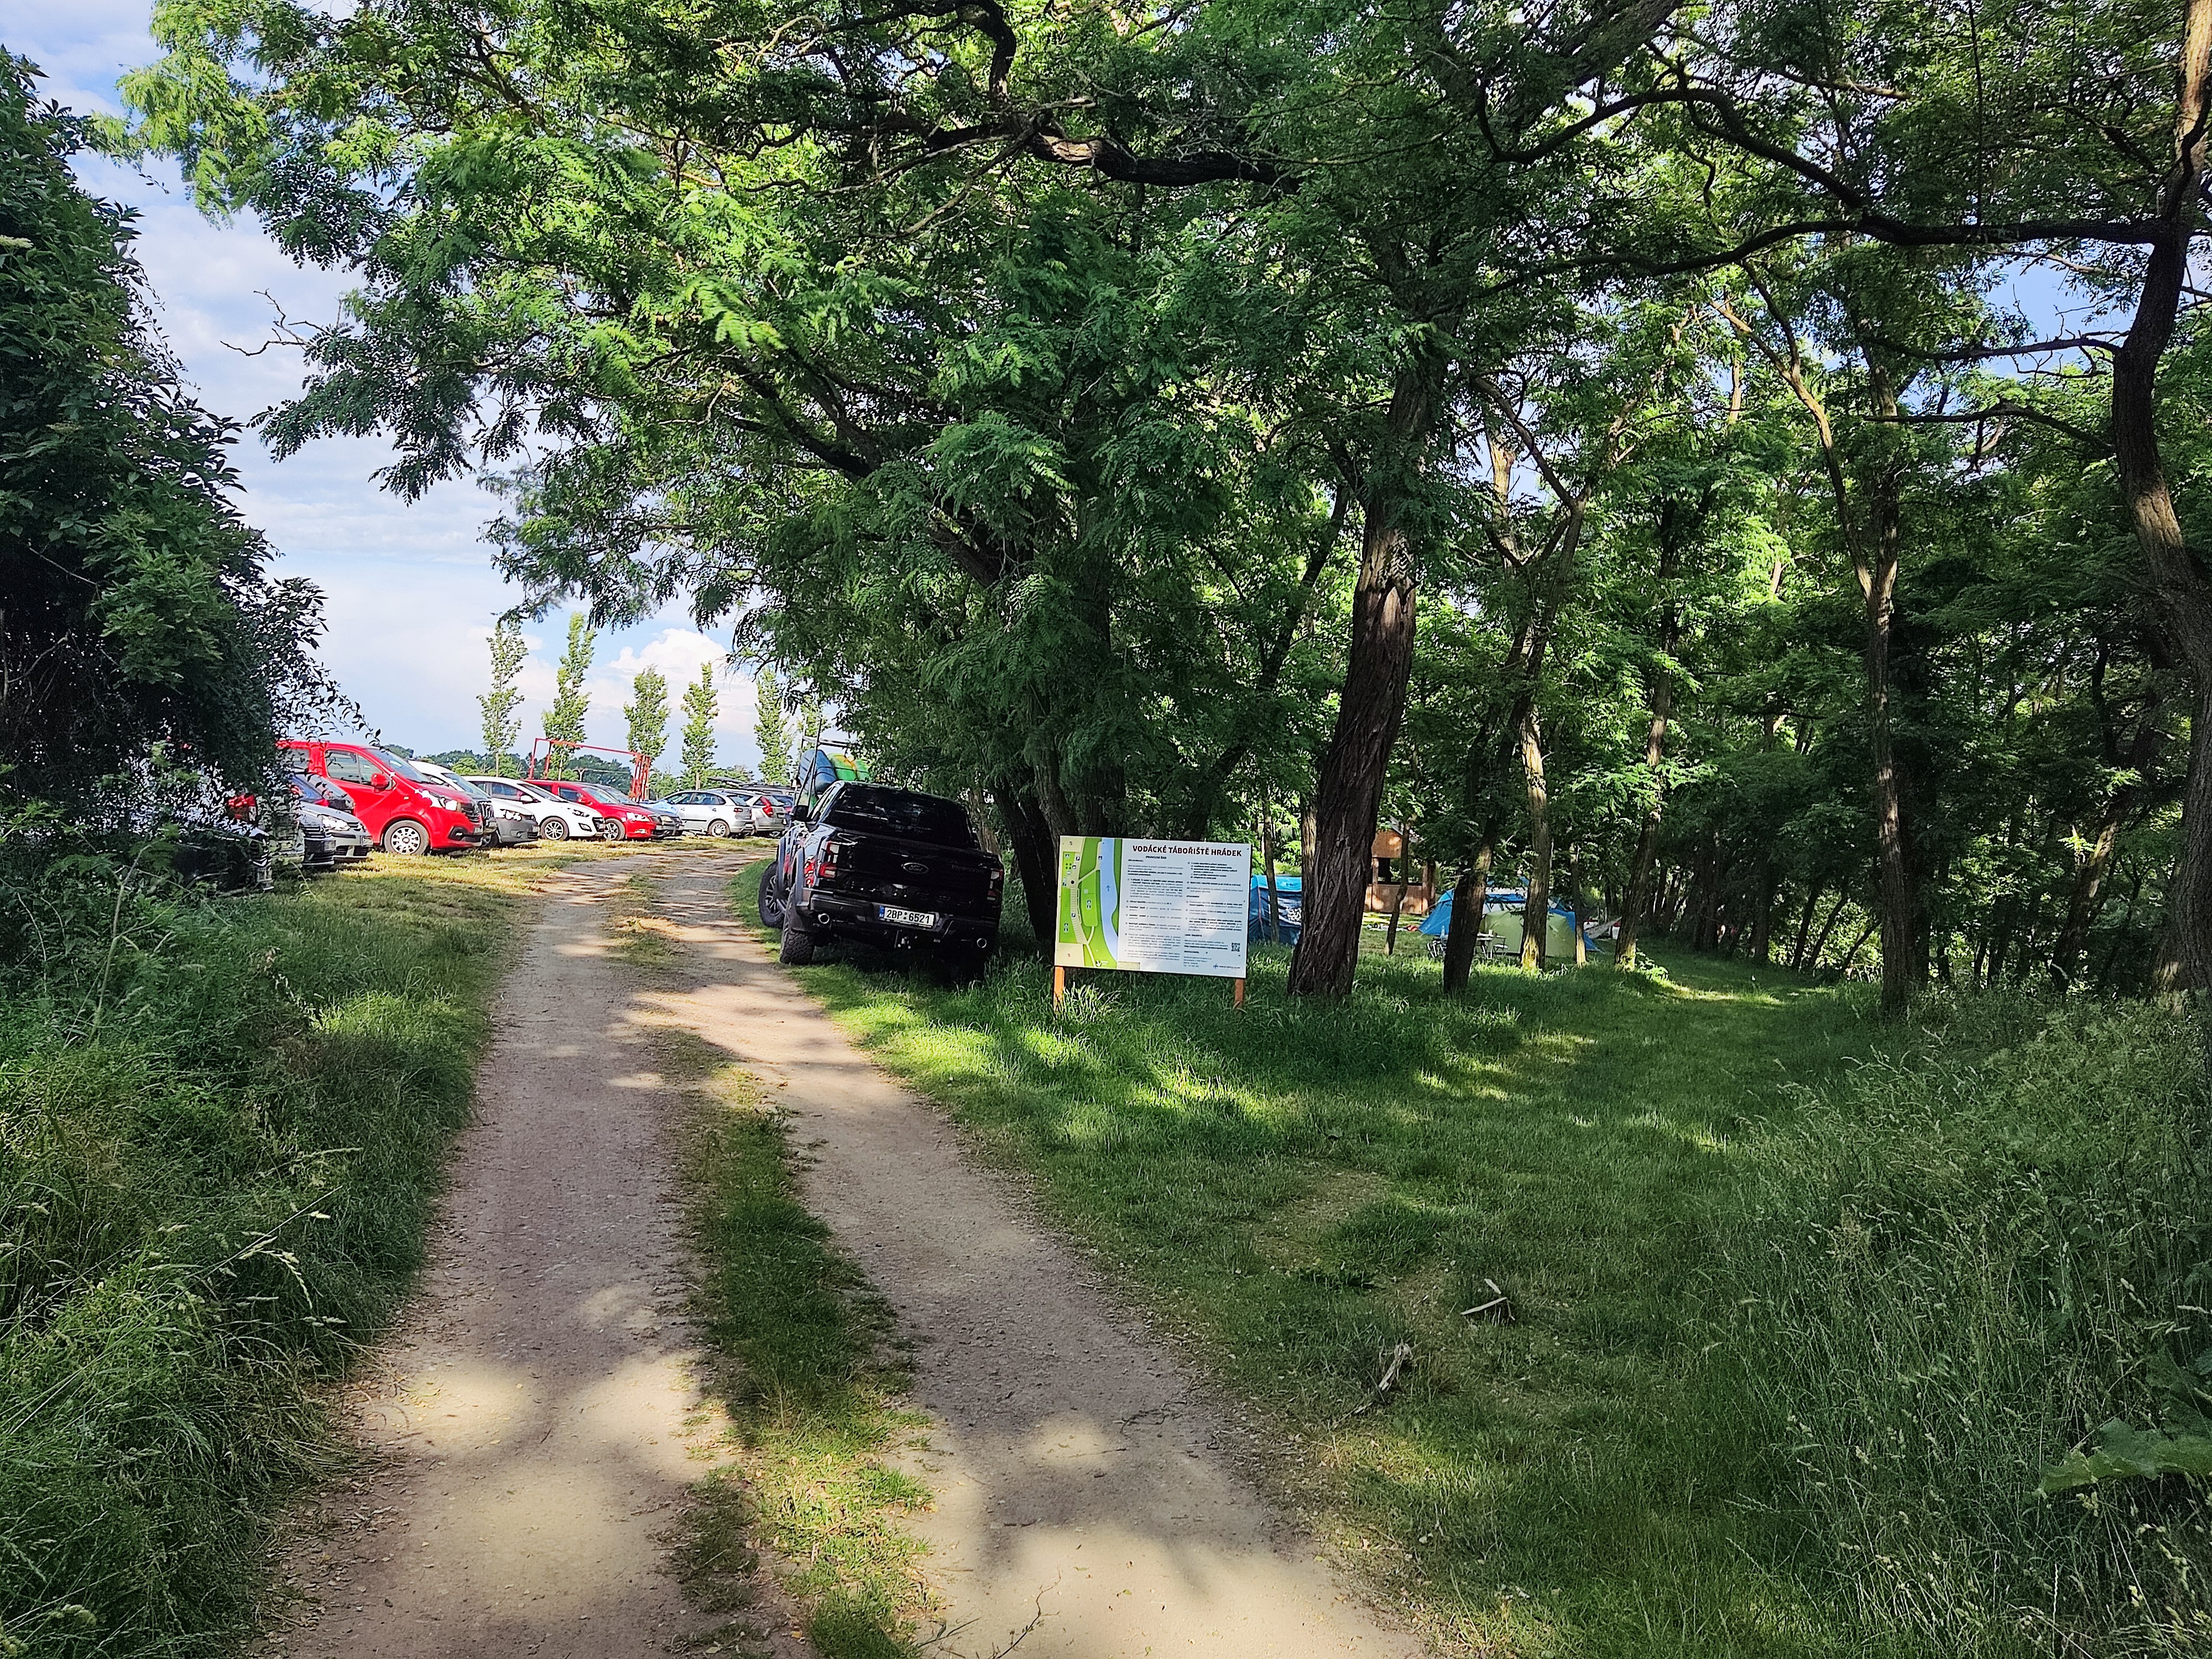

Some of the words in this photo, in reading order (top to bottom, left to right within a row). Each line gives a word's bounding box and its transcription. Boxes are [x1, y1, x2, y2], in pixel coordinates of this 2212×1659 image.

[1133, 844, 1166, 853] VODÁCKÉ
[1168, 846, 1209, 855] TÁBOŘIŠTĚ
[1212, 848, 1242, 857] HRÁDEK
[886, 910, 902, 919] 2BP
[909, 913, 930, 924] 6521
